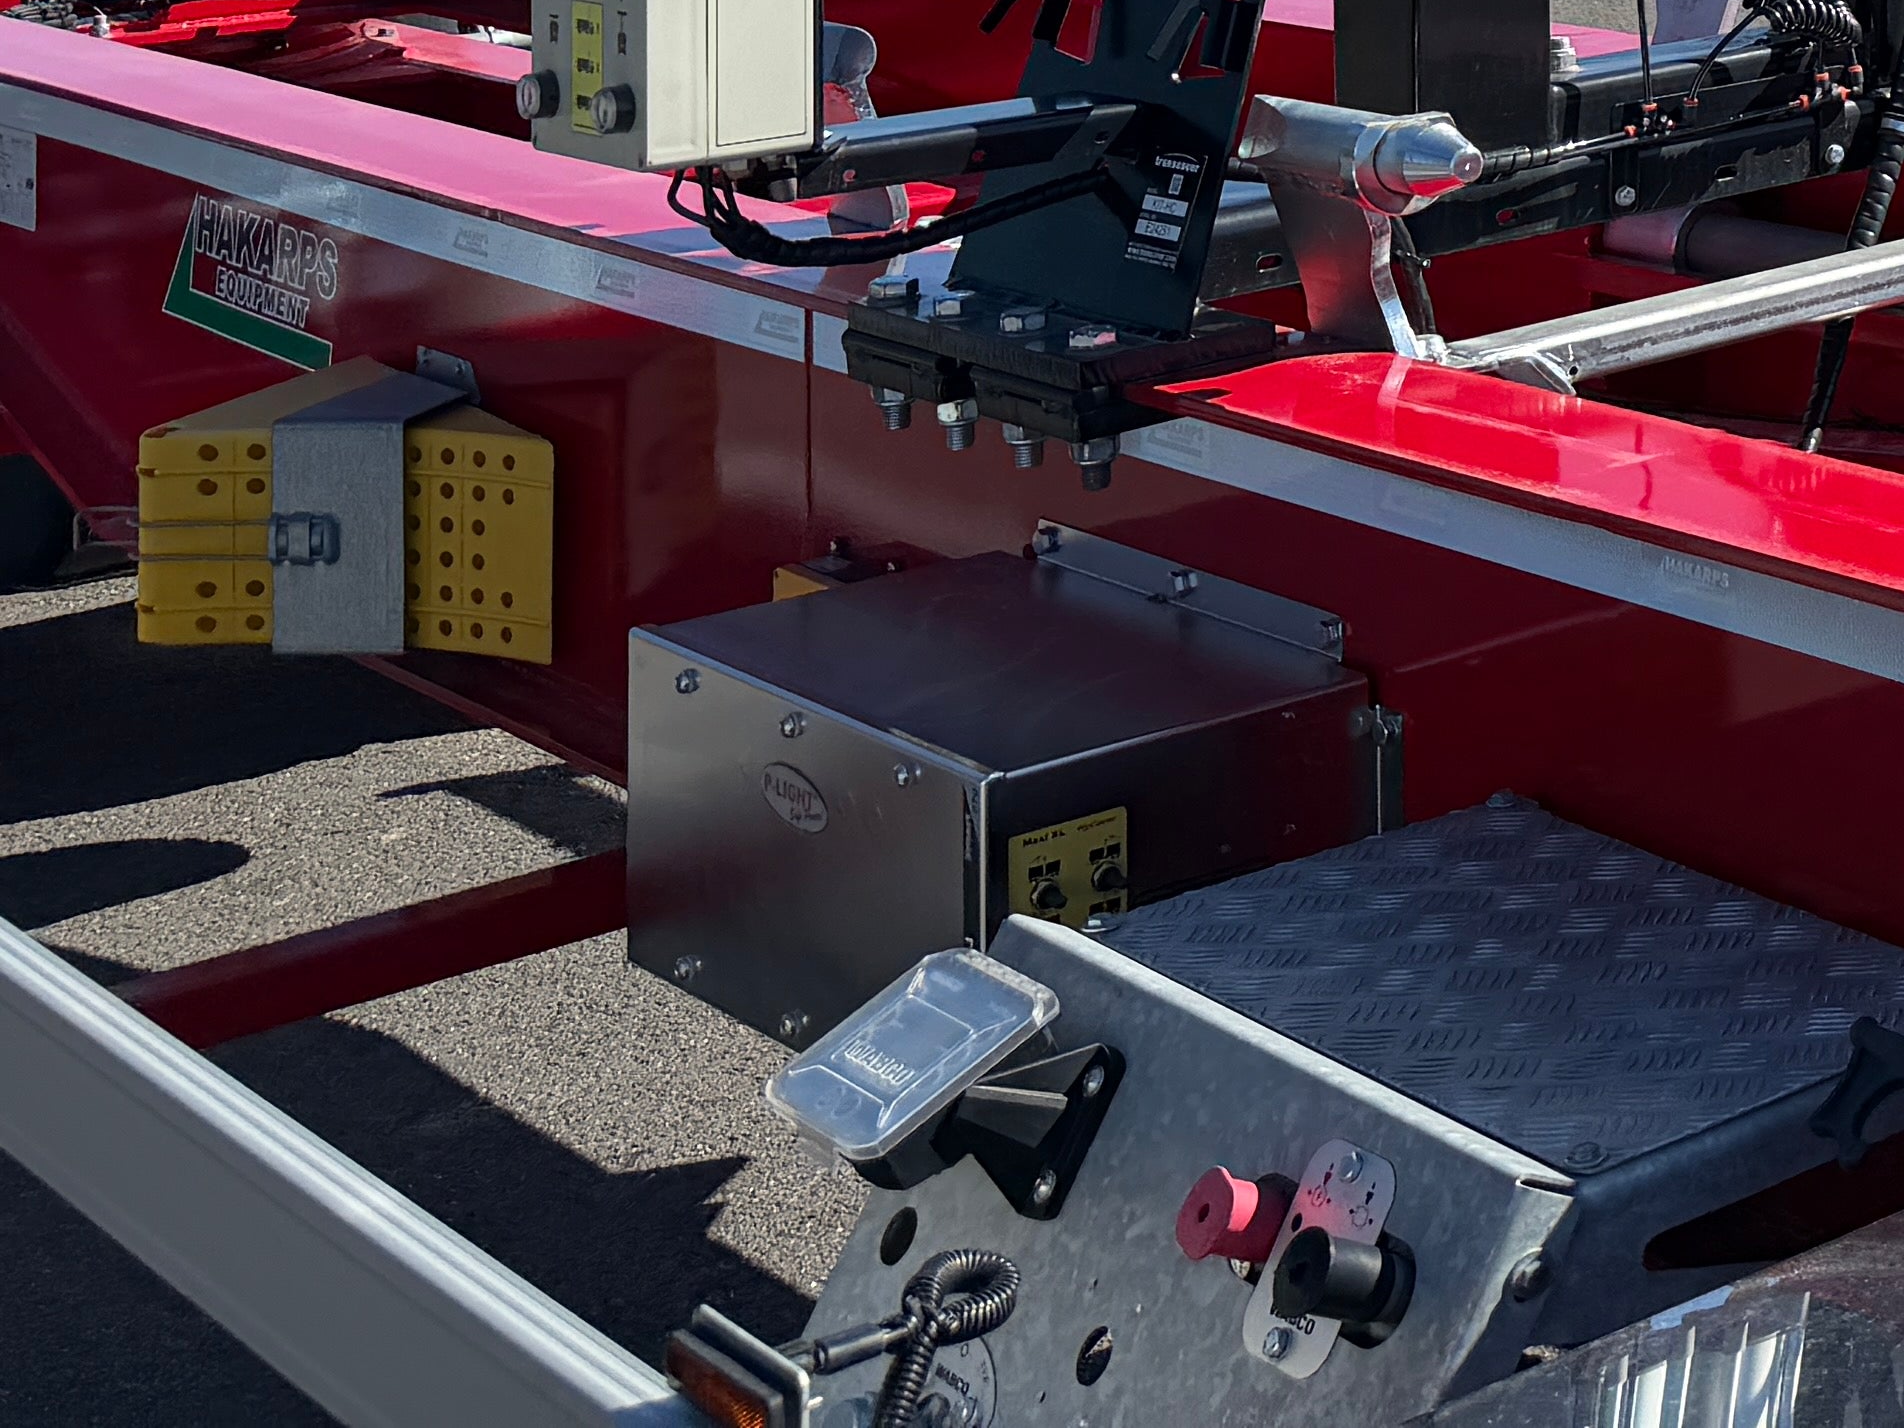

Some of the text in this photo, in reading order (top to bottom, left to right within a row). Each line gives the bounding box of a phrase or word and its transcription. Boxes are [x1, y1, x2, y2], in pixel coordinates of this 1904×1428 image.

[195, 195, 338, 301] HAKARPS
[215, 265, 310, 329] EQUIPMENT
[764, 773, 812, 812] P-LIGHT
[844, 1039, 915, 1085] WABCO
[935, 1362, 970, 1396] WABCO
